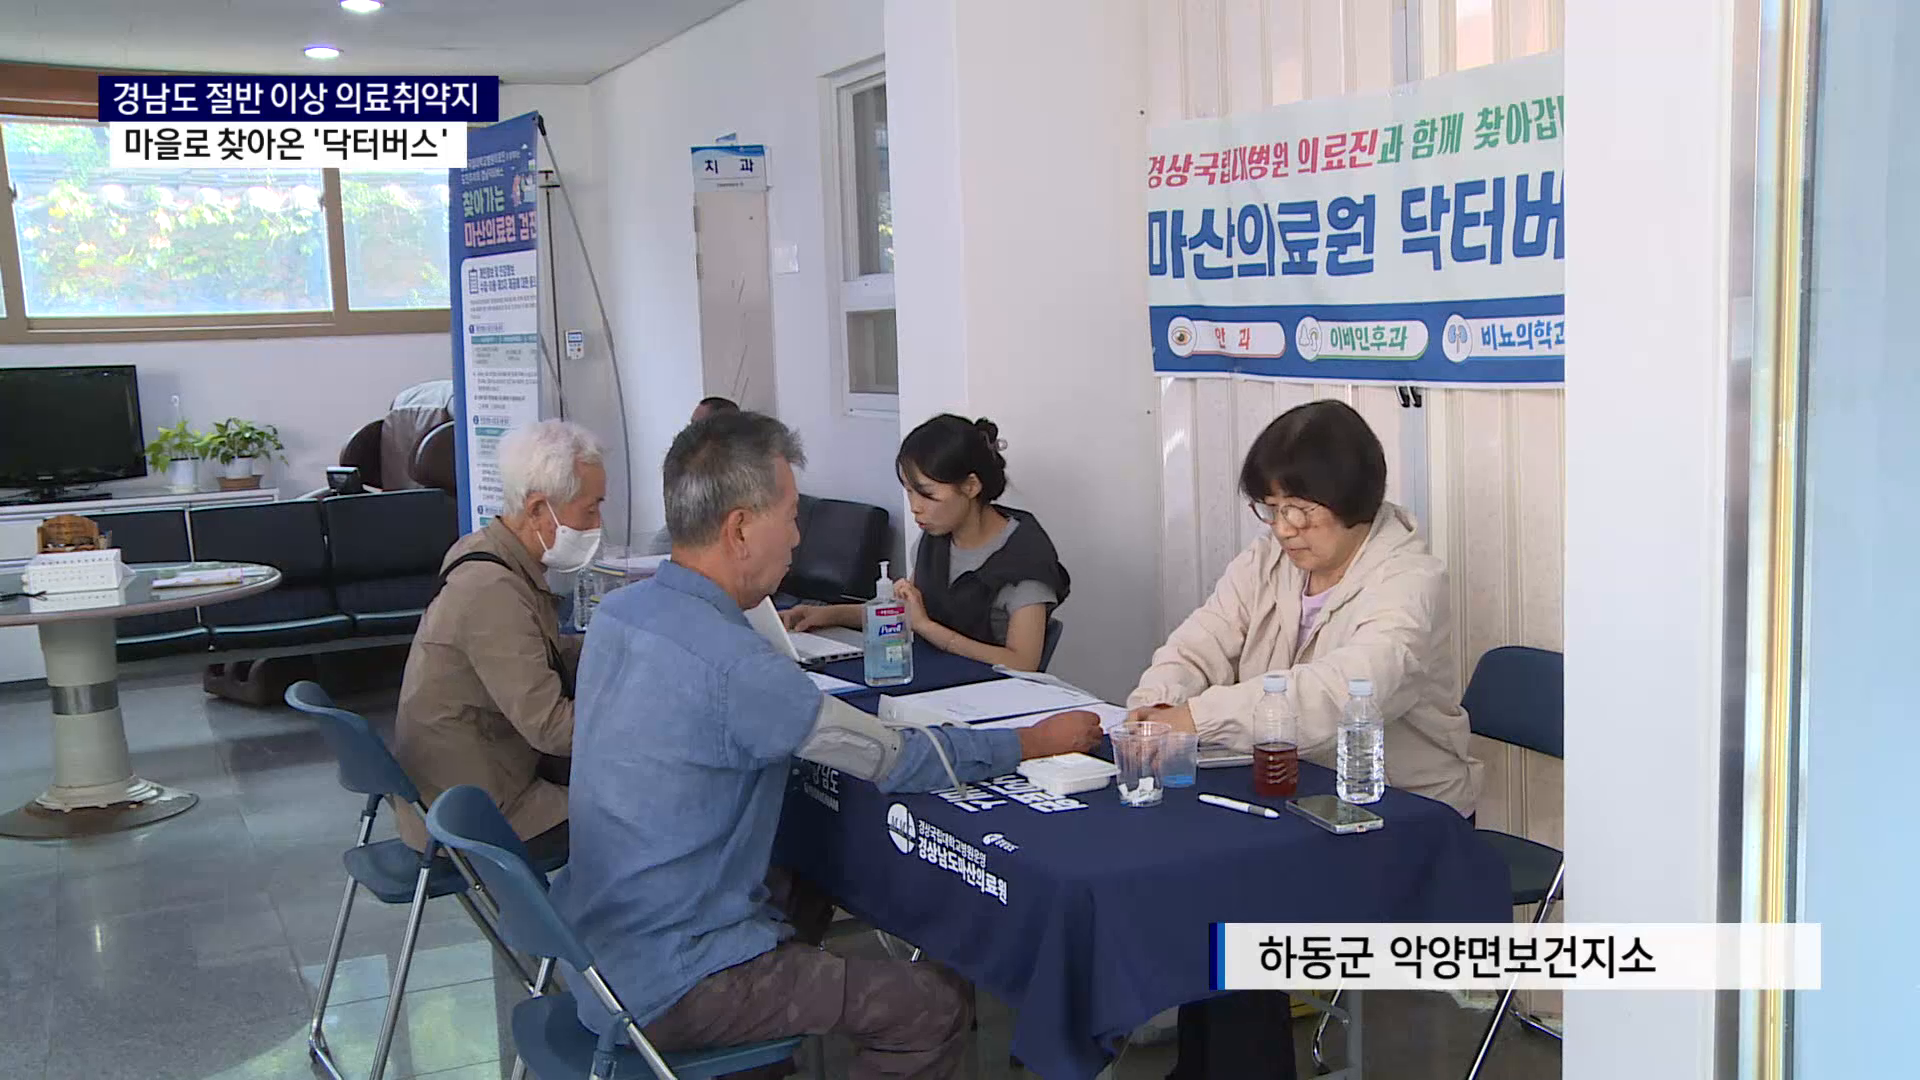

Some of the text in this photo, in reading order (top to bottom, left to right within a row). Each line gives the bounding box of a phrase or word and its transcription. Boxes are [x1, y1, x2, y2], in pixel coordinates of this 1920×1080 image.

[1148, 95, 1564, 189] 경상국립대병원 의료진과 함께 찾아갑
[462, 185, 505, 218] 찾아가는
[464, 214, 517, 248] 마산의료원
[1148, 193, 1377, 281] 마산의료원
[1329, 324, 1409, 352] 이비인후과
[918, 836, 1008, 905] 경상남도마산의료원
